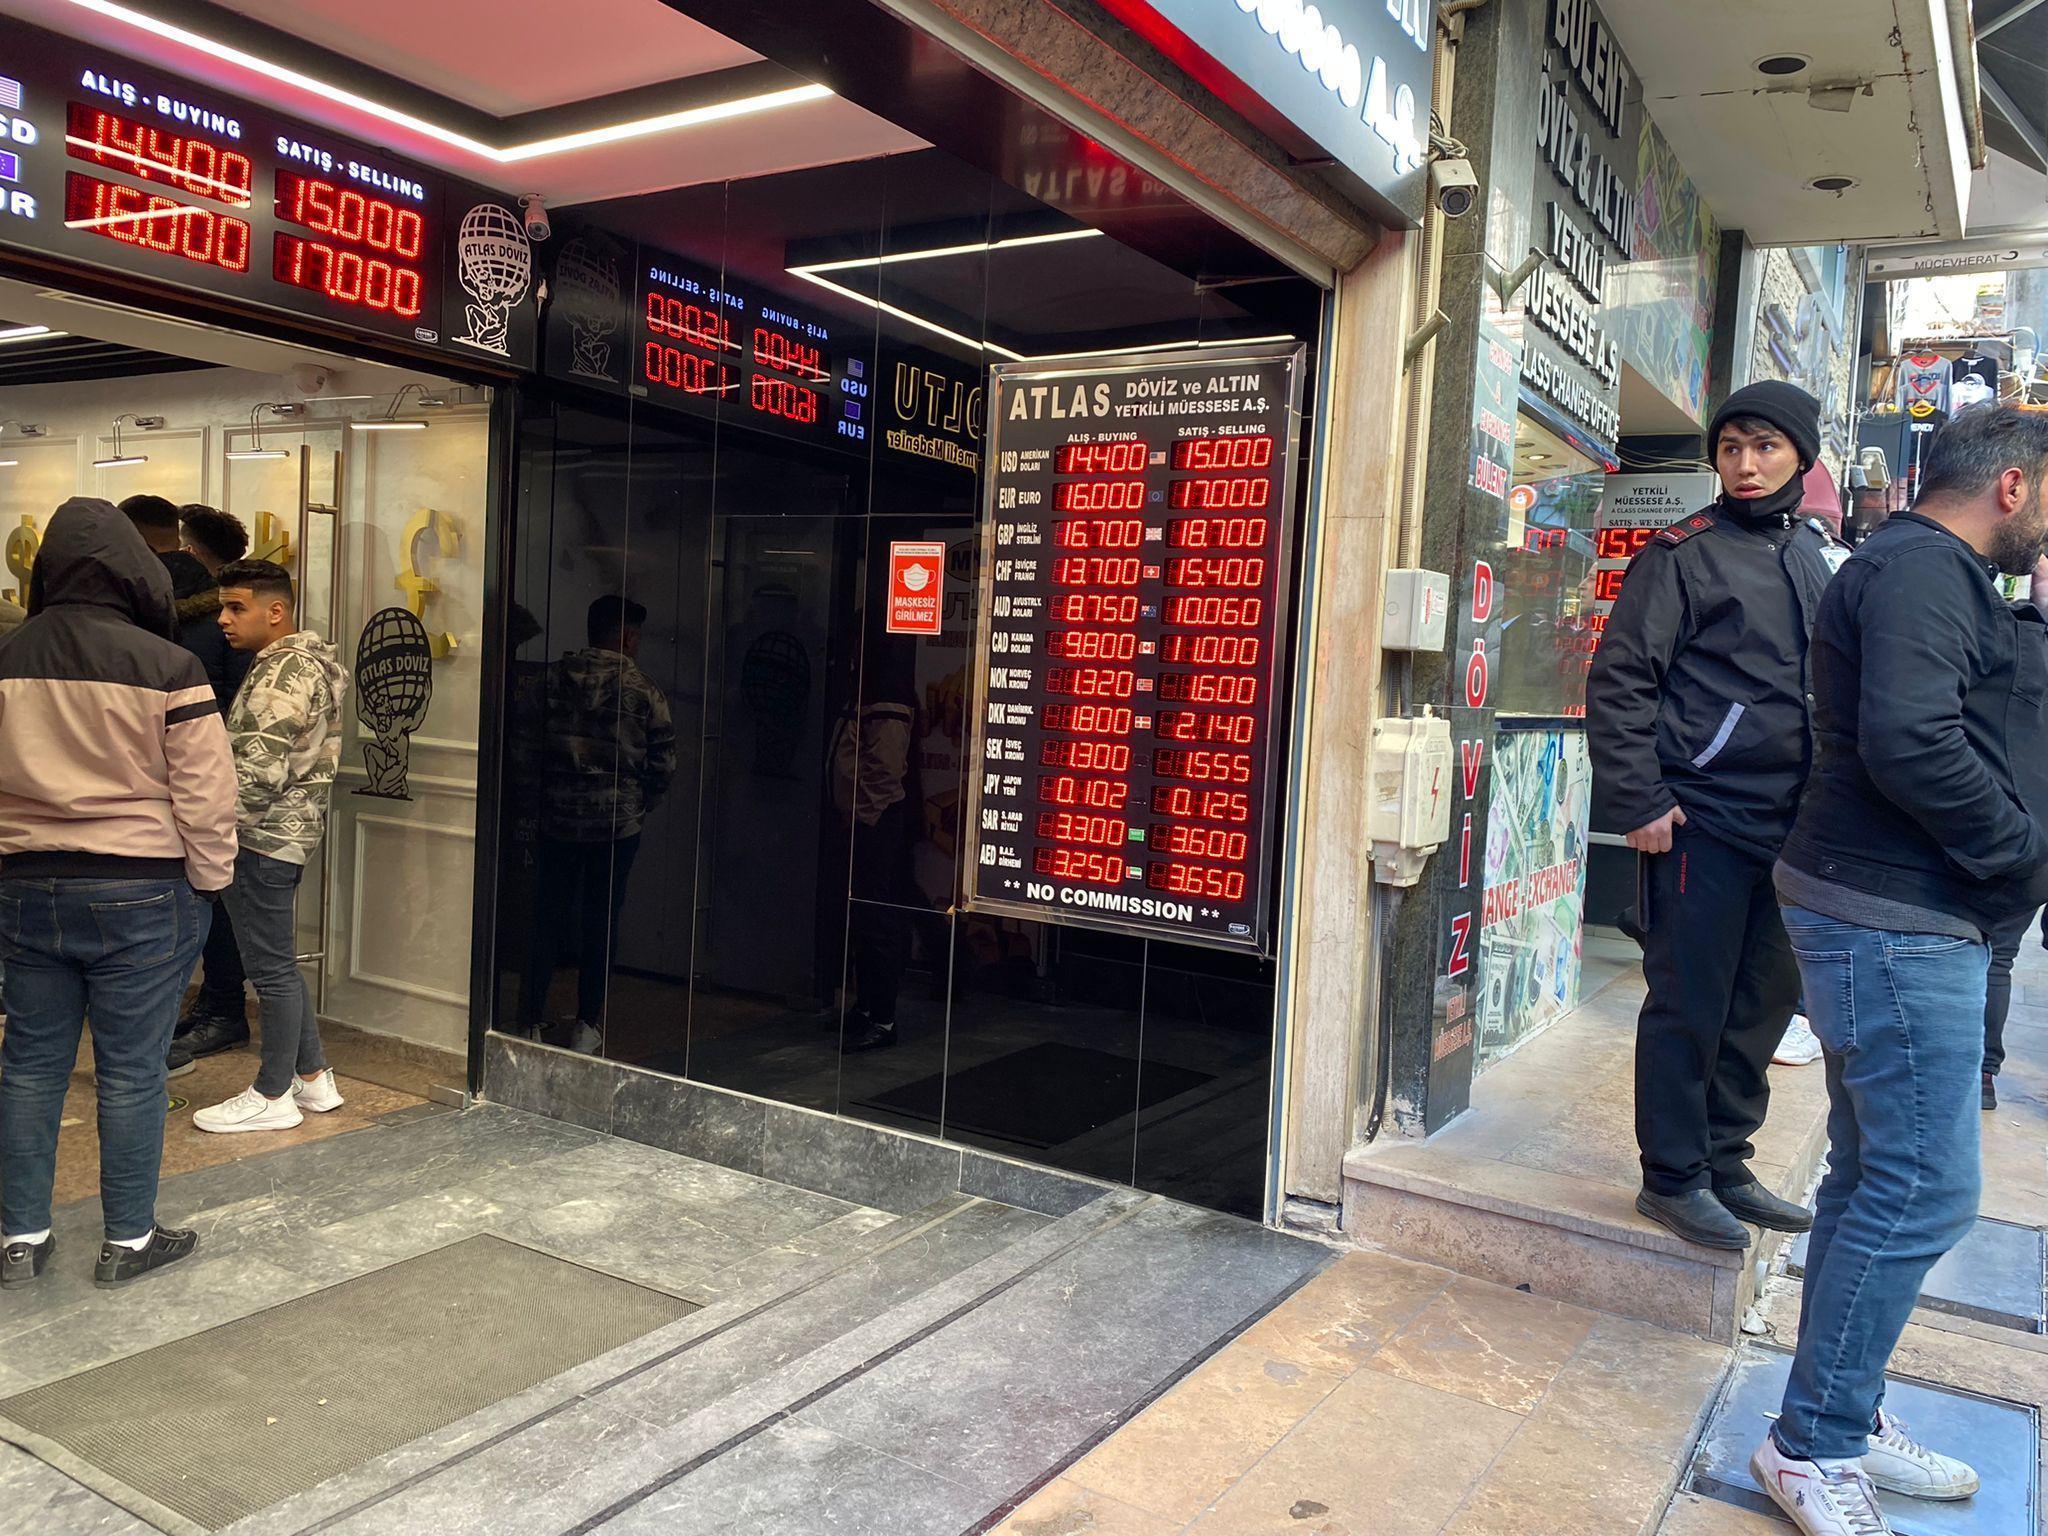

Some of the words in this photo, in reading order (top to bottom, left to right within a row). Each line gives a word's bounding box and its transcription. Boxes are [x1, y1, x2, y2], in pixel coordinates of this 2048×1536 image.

[81, 70, 136, 107] ALIŞ
[157, 94, 241, 139] BUYING
[94, 113, 250, 206] 14.400
[277, 136, 332, 172] SATIŞ
[349, 161, 424, 200] SELLING
[1537, 48, 1579, 188] ÖVİZ
[1579, 132, 1591, 208] &
[1592, 152, 1635, 262] ALTIN
[93, 183, 249, 271] 16.000
[296, 180, 422, 258] 15.000
[465, 243, 497, 258] ATLAS
[499, 243, 529, 264] DÖVİZ
[1553, 202, 1607, 304] YETKİLİ
[293, 242, 420, 316] 17.000
[1009, 383, 1111, 420] ATLAS
[1126, 377, 1178, 399] DÖVİZ
[1182, 382, 1202, 395] ve
[1206, 374, 1260, 395] ALTIN
[1114, 400, 1165, 418] YETKİLİ
[1167, 397, 1240, 416] MÜESSESE
[1242, 396, 1270, 414] A.Ş.
[1551, 364, 1591, 423] CHANGE
[1590, 397, 1621, 443] OFFICE
[1067, 434, 1090, 444] ALIŞ
[1098, 432, 1138, 442] BUYING
[1178, 427, 1209, 438] SATIŞ
[1218, 424, 1266, 436] SELLING
[1001, 451, 1018, 473] USD
[1020, 448, 1050, 460] AMERİKAN
[1019, 462, 1041, 472] DOLARI
[1068, 443, 1147, 473] 14.400
[1185, 437, 1273, 470] 15.000
[999, 487, 1016, 509] EUR
[1018, 491, 1041, 504] EURO
[1066, 481, 1145, 510] 16.000
[1184, 478, 1270, 508] 17.000
[1614, 496, 1663, 506] MÜESSESE
[1666, 497, 1684, 507] A.Ş.
[1632, 485, 1668, 496] YETKİLİ
[997, 523, 1015, 546] GBP
[1064, 520, 1143, 548] 16.700
[1181, 518, 1268, 548] 18.700
[1609, 519, 1632, 528] SATIŞ
[1640, 519, 1654, 527] WE
[995, 559, 1013, 582] CHF
[1014, 570, 1035, 581] FRANGI
[1062, 557, 1141, 585] 13.700
[1178, 558, 1265, 587] 15.400
[895, 595, 936, 609] MASKESİZ
[895, 609, 934, 623] GİRİLMEZ
[993, 596, 1011, 617] AUD
[1012, 606, 1033, 617] DOLARI
[1066, 594, 1138, 623] 8.750
[1175, 596, 1262, 626] 10.060
[991, 631, 1009, 654] CAD
[1011, 632, 1034, 643] KANADA
[1010, 644, 1032, 654] DOLARI
[1066, 631, 1136, 660] 9.800
[1173, 636, 1260, 666] 11.000
[360, 657, 393, 686] ATLAS
[396, 652, 430, 673] DÖVİZ
[989, 667, 1008, 689] NOK
[1073, 668, 1134, 698] 1.320
[1008, 680, 1029, 690] KRONU
[1190, 674, 1257, 705] 1.600
[987, 702, 1006, 725] DKK
[1006, 715, 1027, 726] KRONU
[1071, 705, 1132, 735] 1.800
[1176, 711, 1255, 744] 2.140
[986, 737, 1003, 760] SEK
[1004, 750, 1025, 762] KRONU
[1069, 742, 1130, 772] 1.300
[1186, 751, 1250, 783] 1.555
[983, 773, 1001, 795] JPY
[1002, 775, 1022, 786] JAPON
[1002, 785, 1017, 797] YENİ
[1056, 777, 1127, 809] 0.102
[1171, 787, 1248, 822] 0.125
[981, 808, 999, 832] SAR
[1007, 811, 1023, 822] ARAB
[1056, 813, 1126, 846] 3.300
[979, 843, 997, 866] AED
[1170, 825, 1248, 861] 3.600
[1054, 849, 1123, 883] 3.250
[1168, 862, 1245, 900] 3.650
[1527, 858, 1578, 910] EXCHANGE
[1026, 882, 1055, 901] NO
[1060, 887, 1193, 922] COMMISSION
